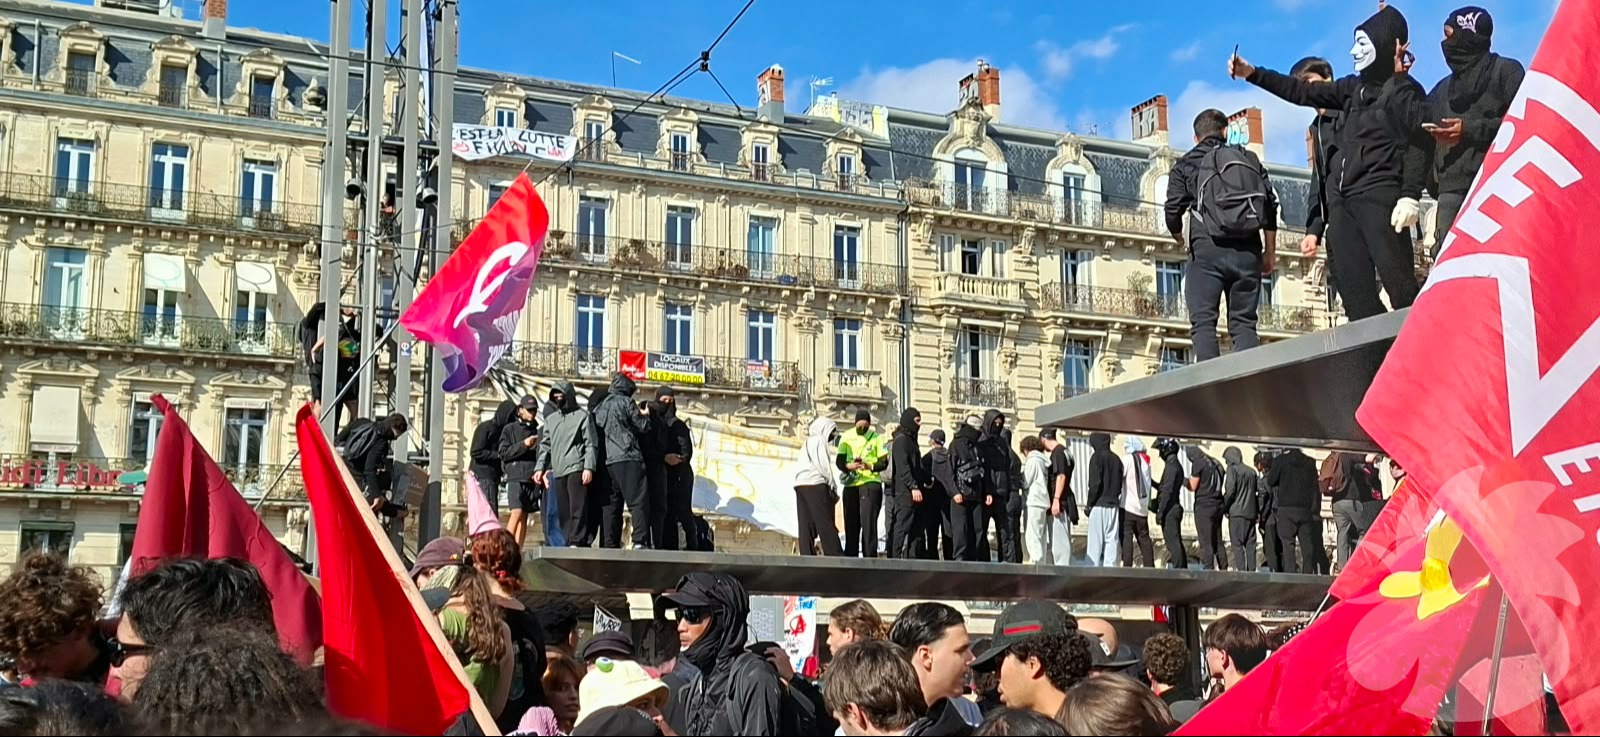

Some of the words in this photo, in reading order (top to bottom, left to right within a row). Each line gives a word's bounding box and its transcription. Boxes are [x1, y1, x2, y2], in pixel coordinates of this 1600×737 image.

[452, 128, 485, 140] 'EST
[518, 130, 565, 149] LUTTE
[653, 361, 697, 373] DISPONIBLES
[660, 354, 691, 365] LOCAUX
[0, 460, 43, 485] idi
[56, 461, 135, 489] Libr
